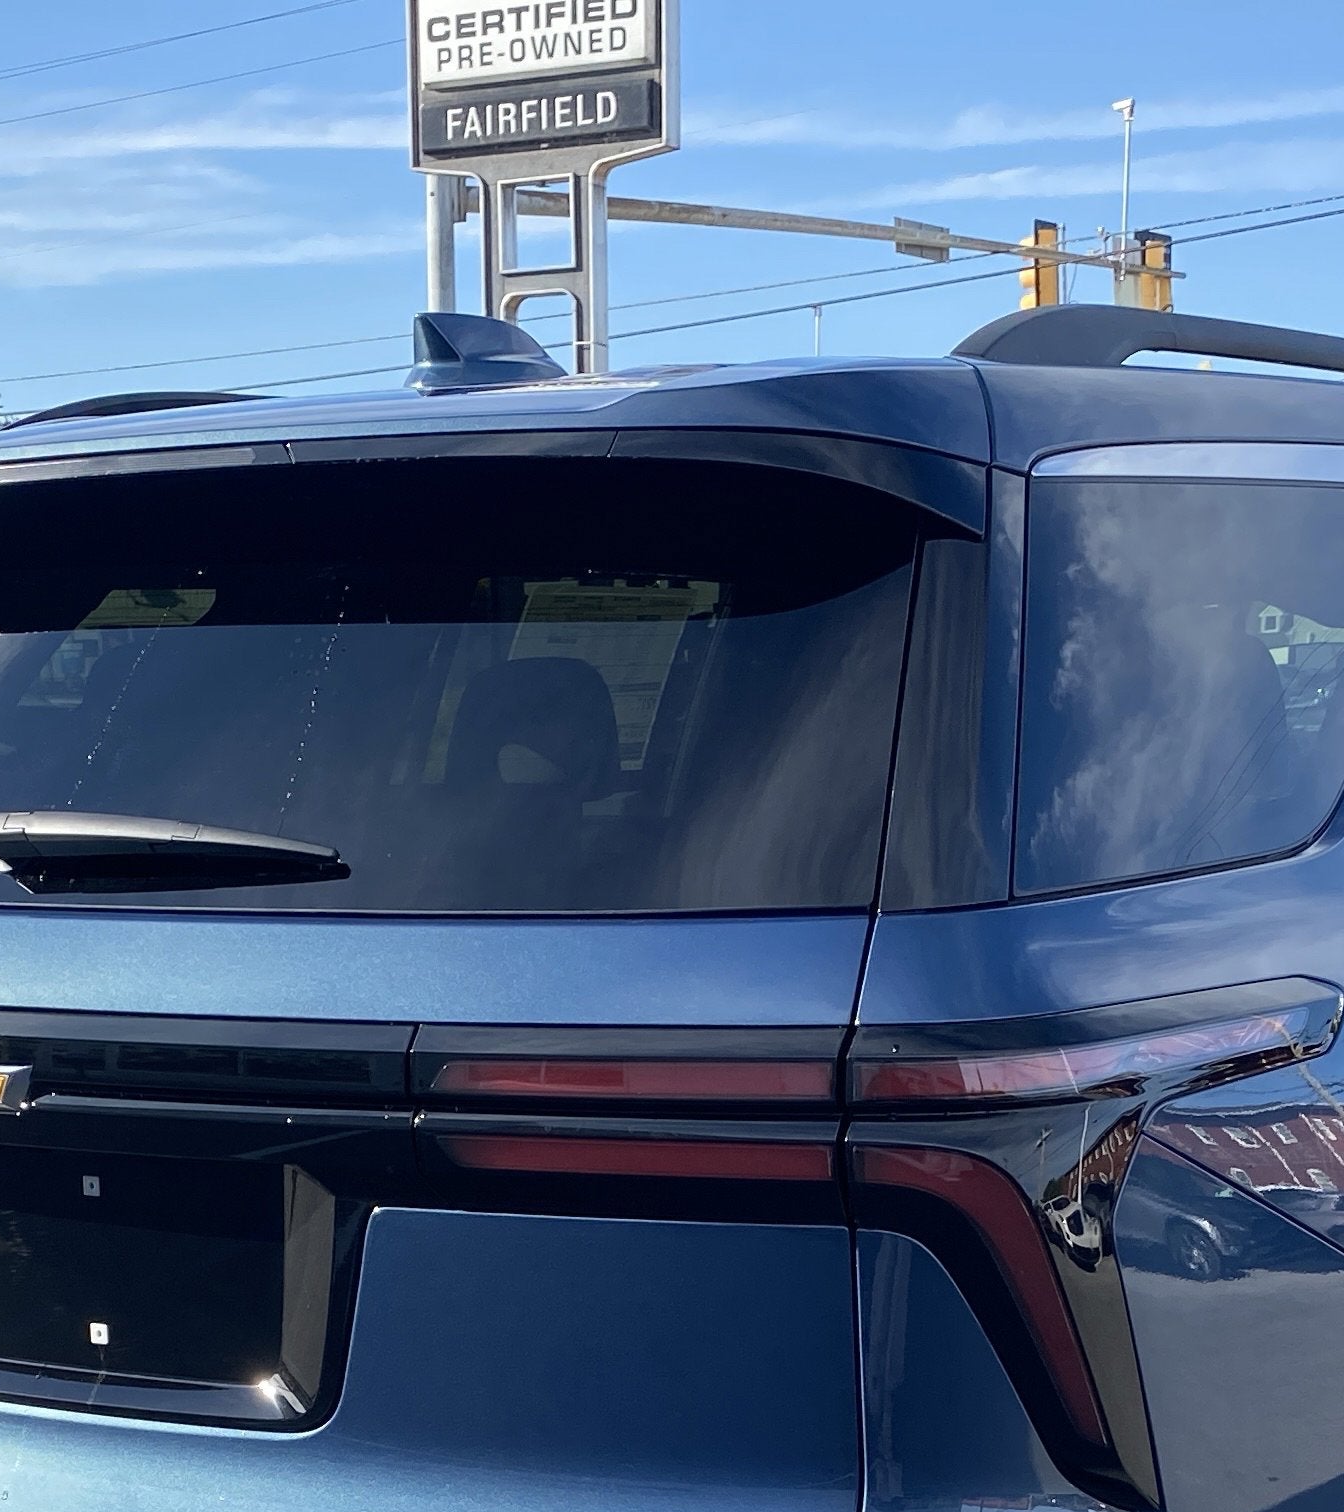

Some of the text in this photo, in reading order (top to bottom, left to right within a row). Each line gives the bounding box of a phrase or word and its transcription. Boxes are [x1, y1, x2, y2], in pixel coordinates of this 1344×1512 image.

[427, 0, 637, 42] CERTIFIED
[437, 26, 628, 72] PRE-OWNED
[446, 91, 619, 141] FAIRFIELD
